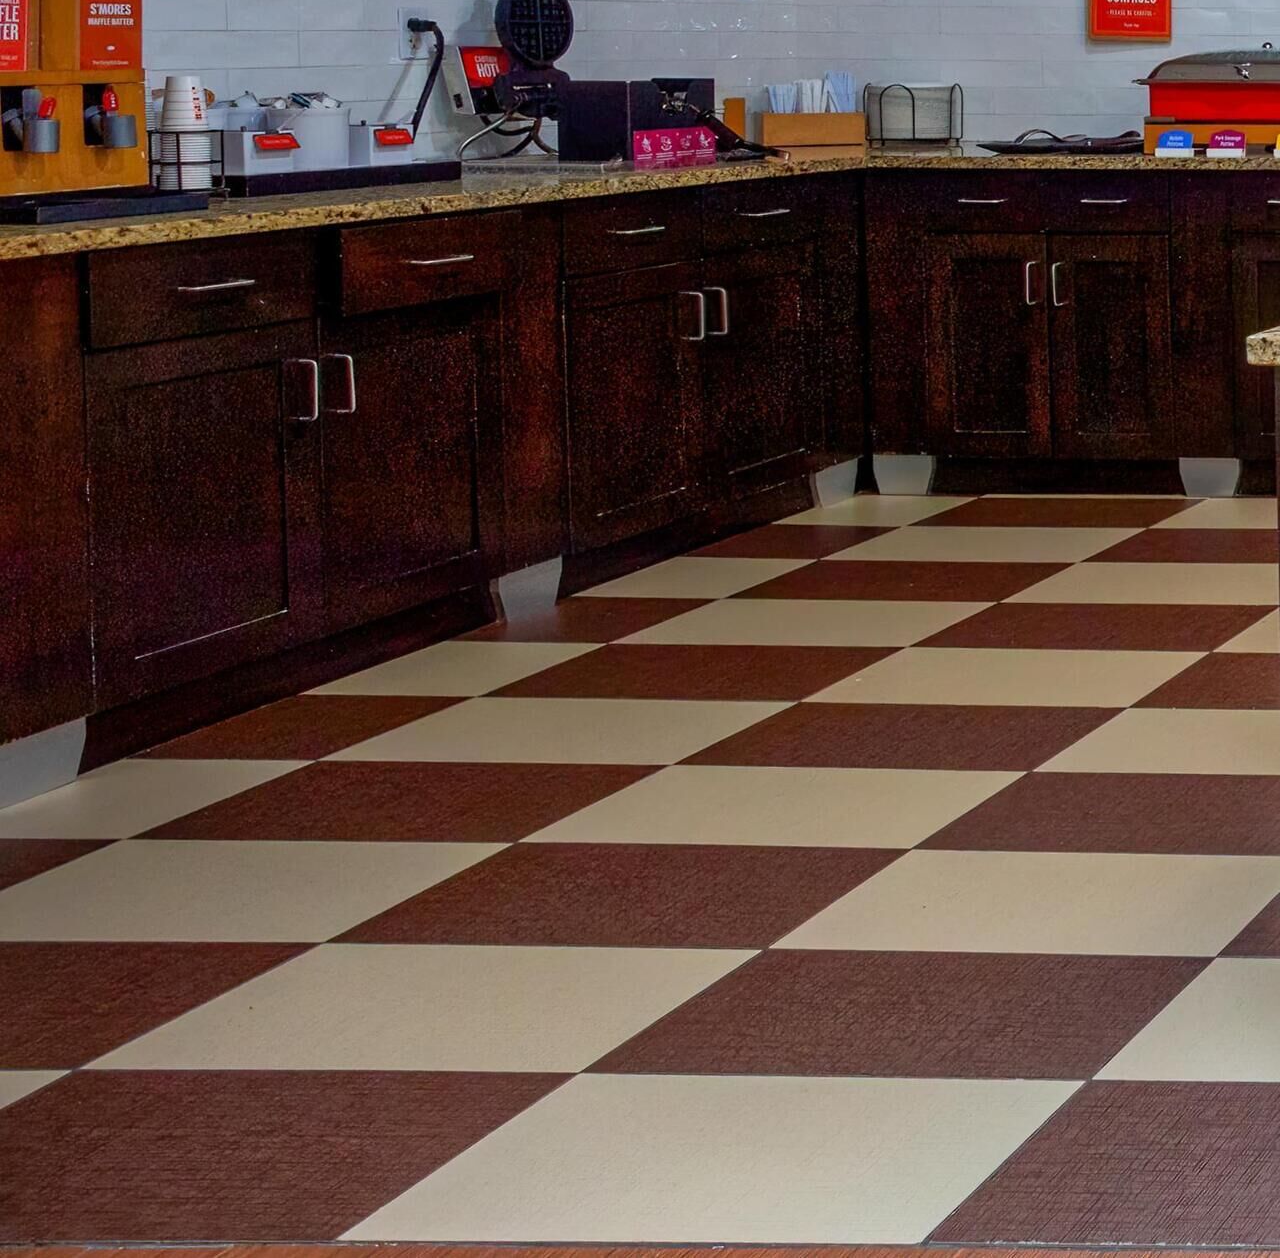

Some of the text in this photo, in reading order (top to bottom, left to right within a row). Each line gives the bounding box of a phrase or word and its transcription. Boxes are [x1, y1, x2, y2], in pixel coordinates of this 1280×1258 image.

[90, 3, 132, 16] S'MORES
[87, 17, 134, 26] WAFFLE BATTER
